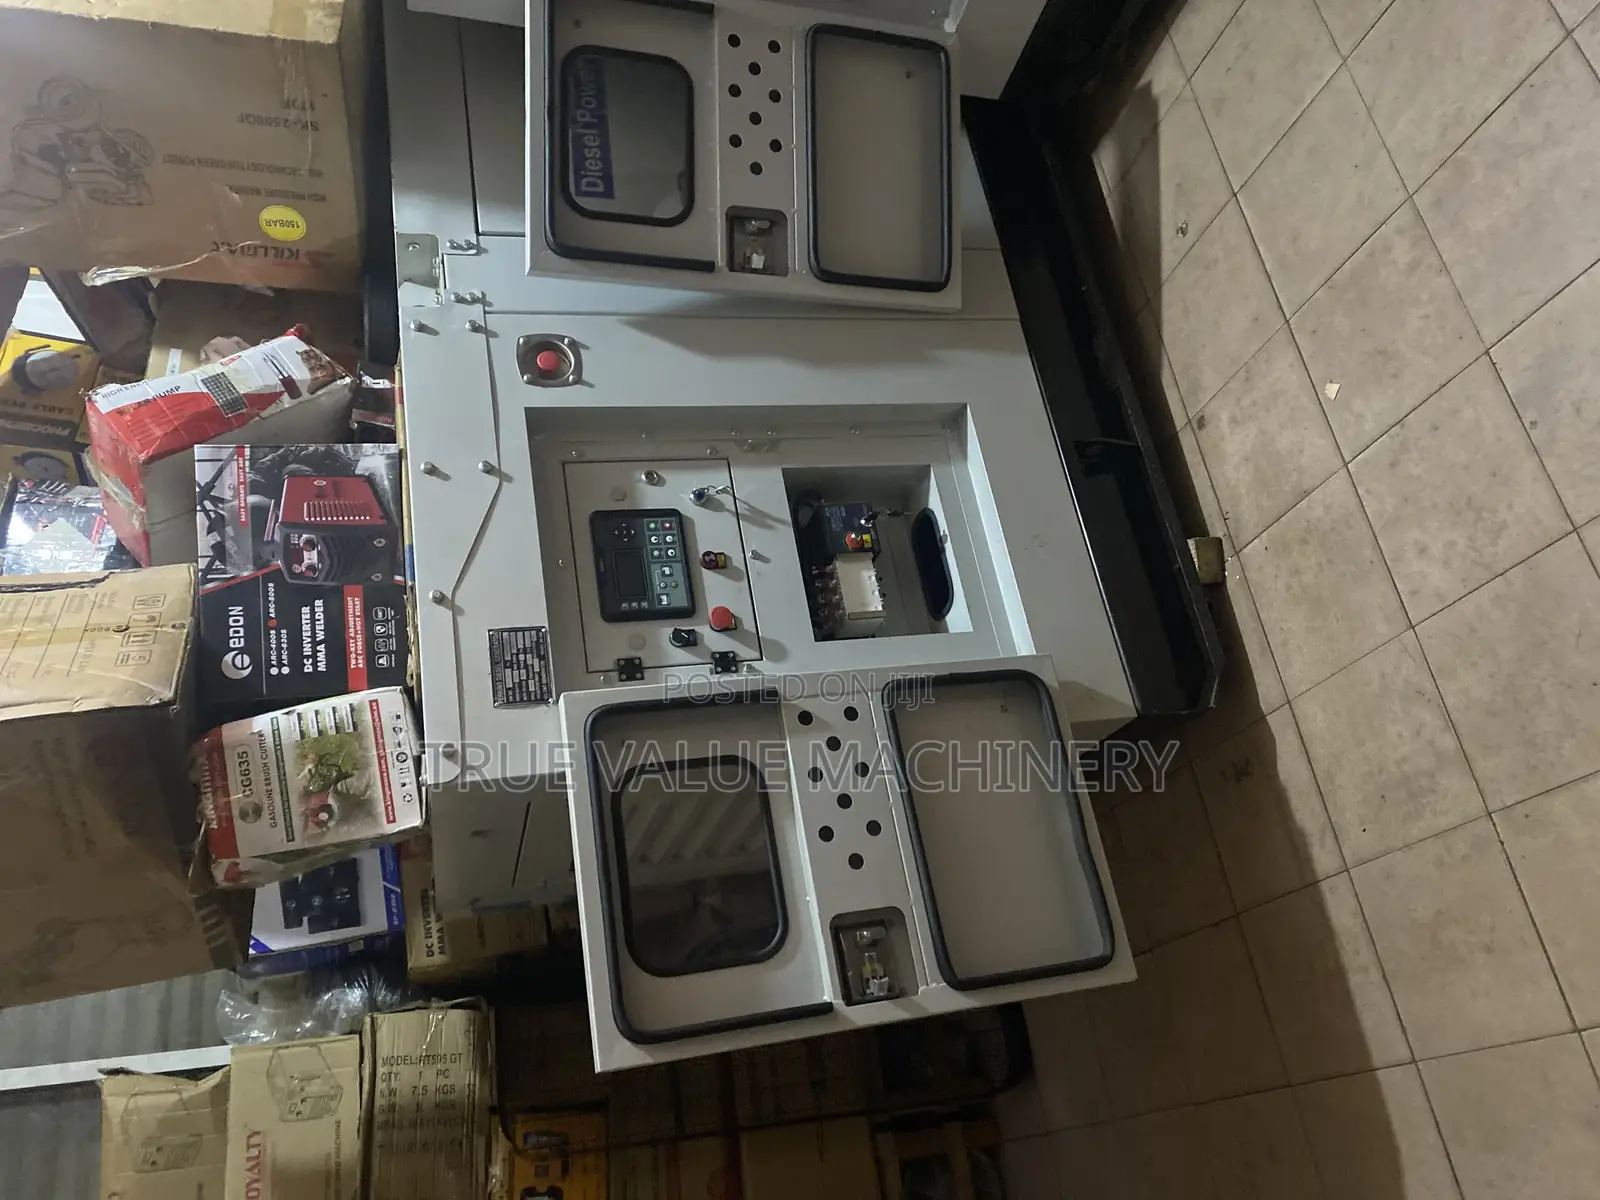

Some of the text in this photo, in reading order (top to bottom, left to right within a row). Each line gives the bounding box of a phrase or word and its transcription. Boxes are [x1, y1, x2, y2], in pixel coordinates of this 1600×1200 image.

[577, 127, 605, 193] Diesel
[264, 217, 301, 229] 150BAR
[101, 387, 123, 400] HIGH
[152, 385, 181, 400] PUMP
[267, 582, 277, 666] ARC-400S ARC-500S
[301, 606, 313, 673] DC INVERTER
[314, 598, 327, 672] MMA WELDER
[347, 596, 357, 669] TWO-KEY ADJUSTMENT
[280, 628, 288, 665] ARC-630S
[237, 750, 254, 799] CG635
[258, 731, 278, 829] GASOLINE BRUSH CUTTER
[425, 942, 435, 958] DC
[436, 1068, 450, 1079] PC
[450, 1053, 463, 1064] GT
[435, 1083, 456, 1095] KGS
